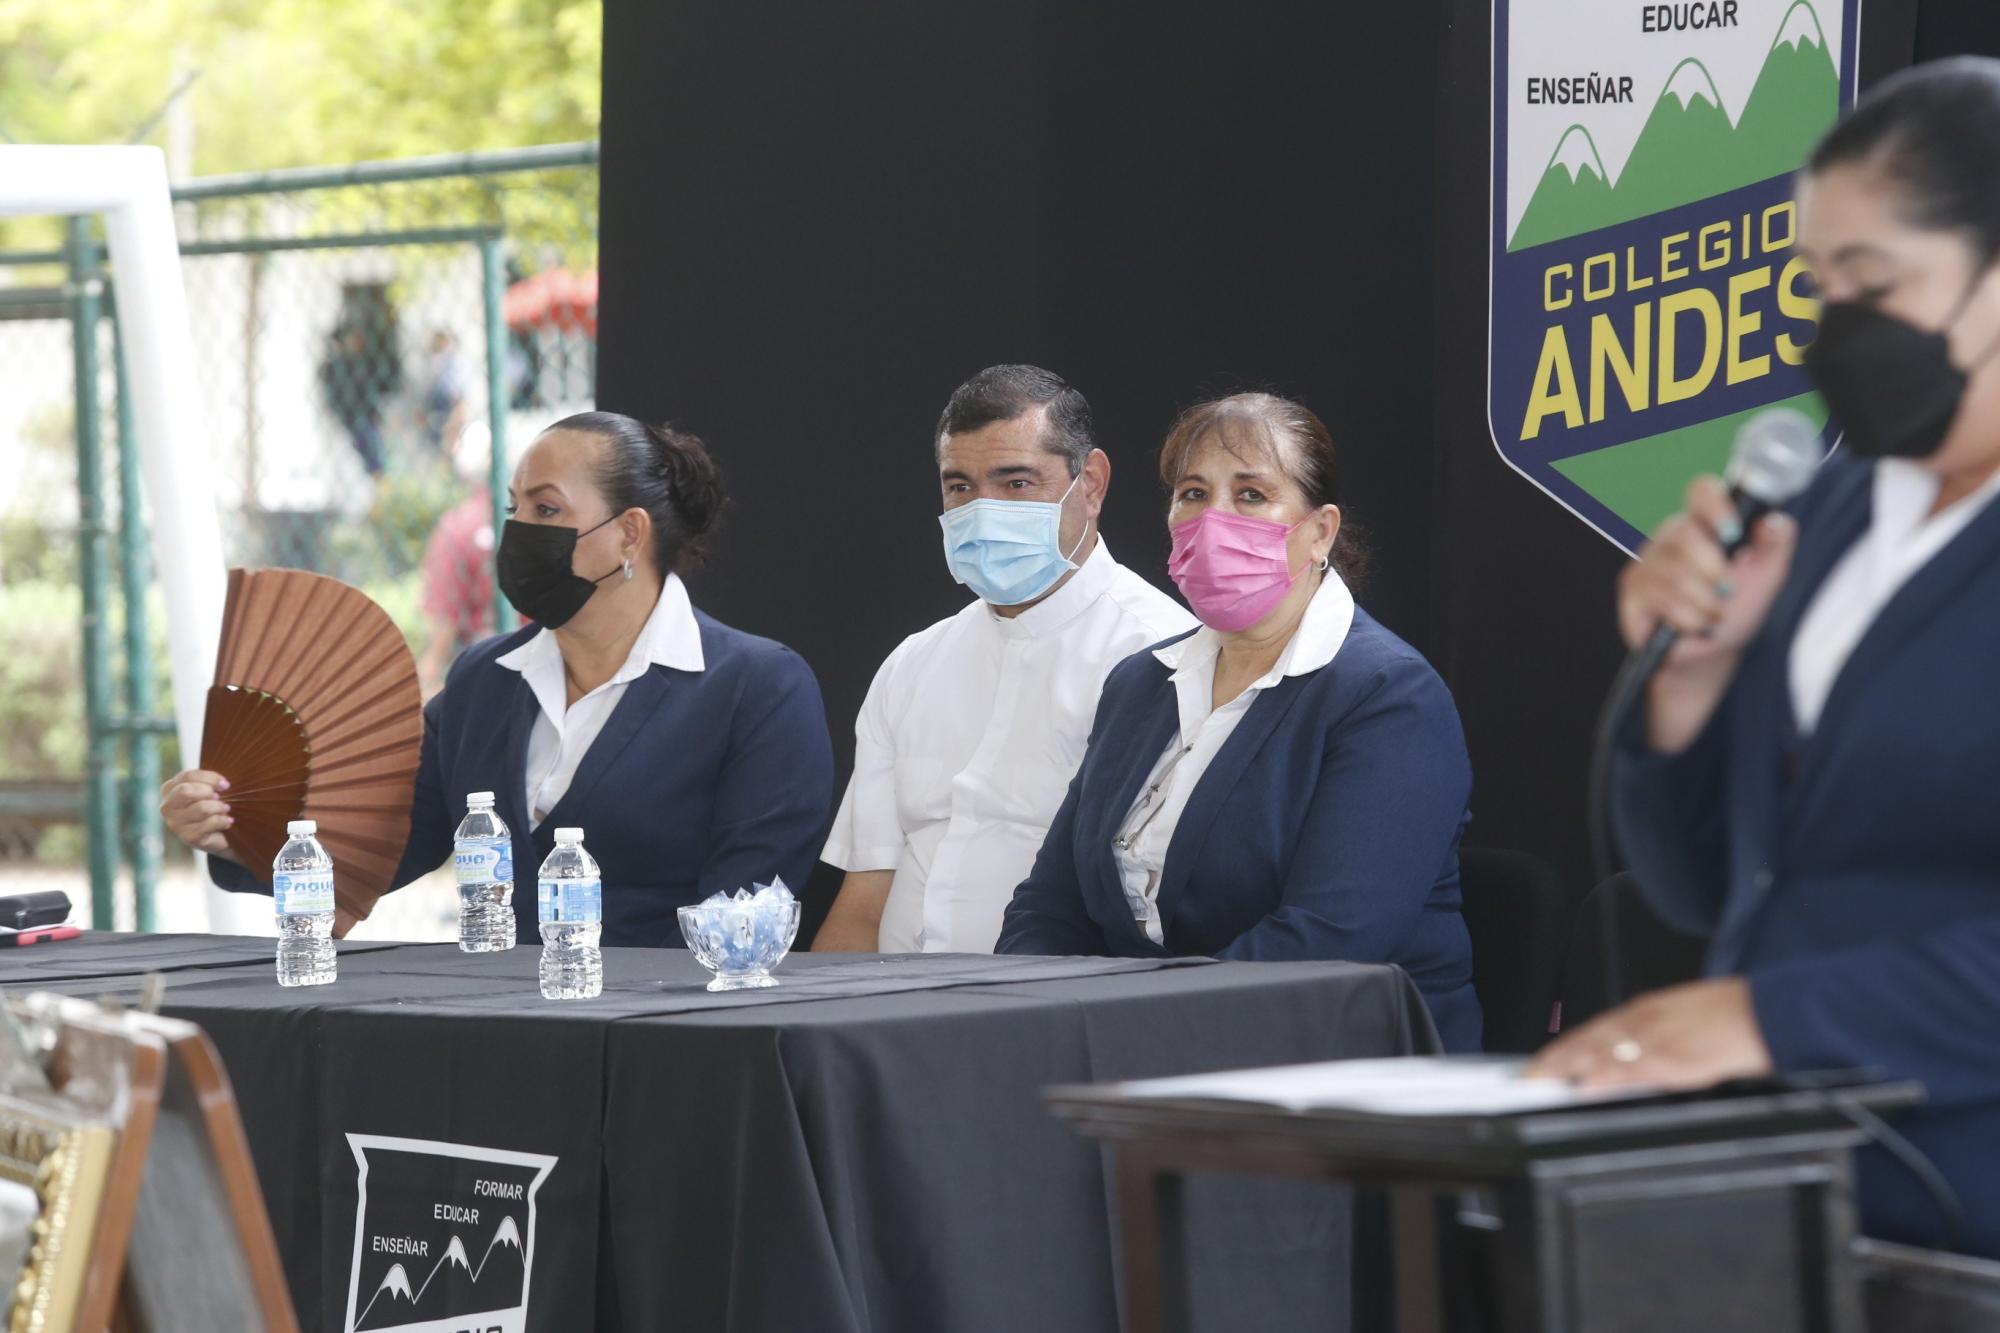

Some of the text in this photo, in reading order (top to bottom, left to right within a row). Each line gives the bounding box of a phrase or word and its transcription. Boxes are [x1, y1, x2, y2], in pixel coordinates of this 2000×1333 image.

[1642, 0, 1738, 33] EDUCAR
[1527, 72, 1634, 105] ENSEÑAR
[1544, 201, 1797, 312] COLEGIO
[1519, 255, 1822, 441] ANDES
[474, 1179, 523, 1201] FORMAR
[433, 1203, 480, 1225] EDUCAR
[372, 1235, 428, 1257] ENSEÑAR
